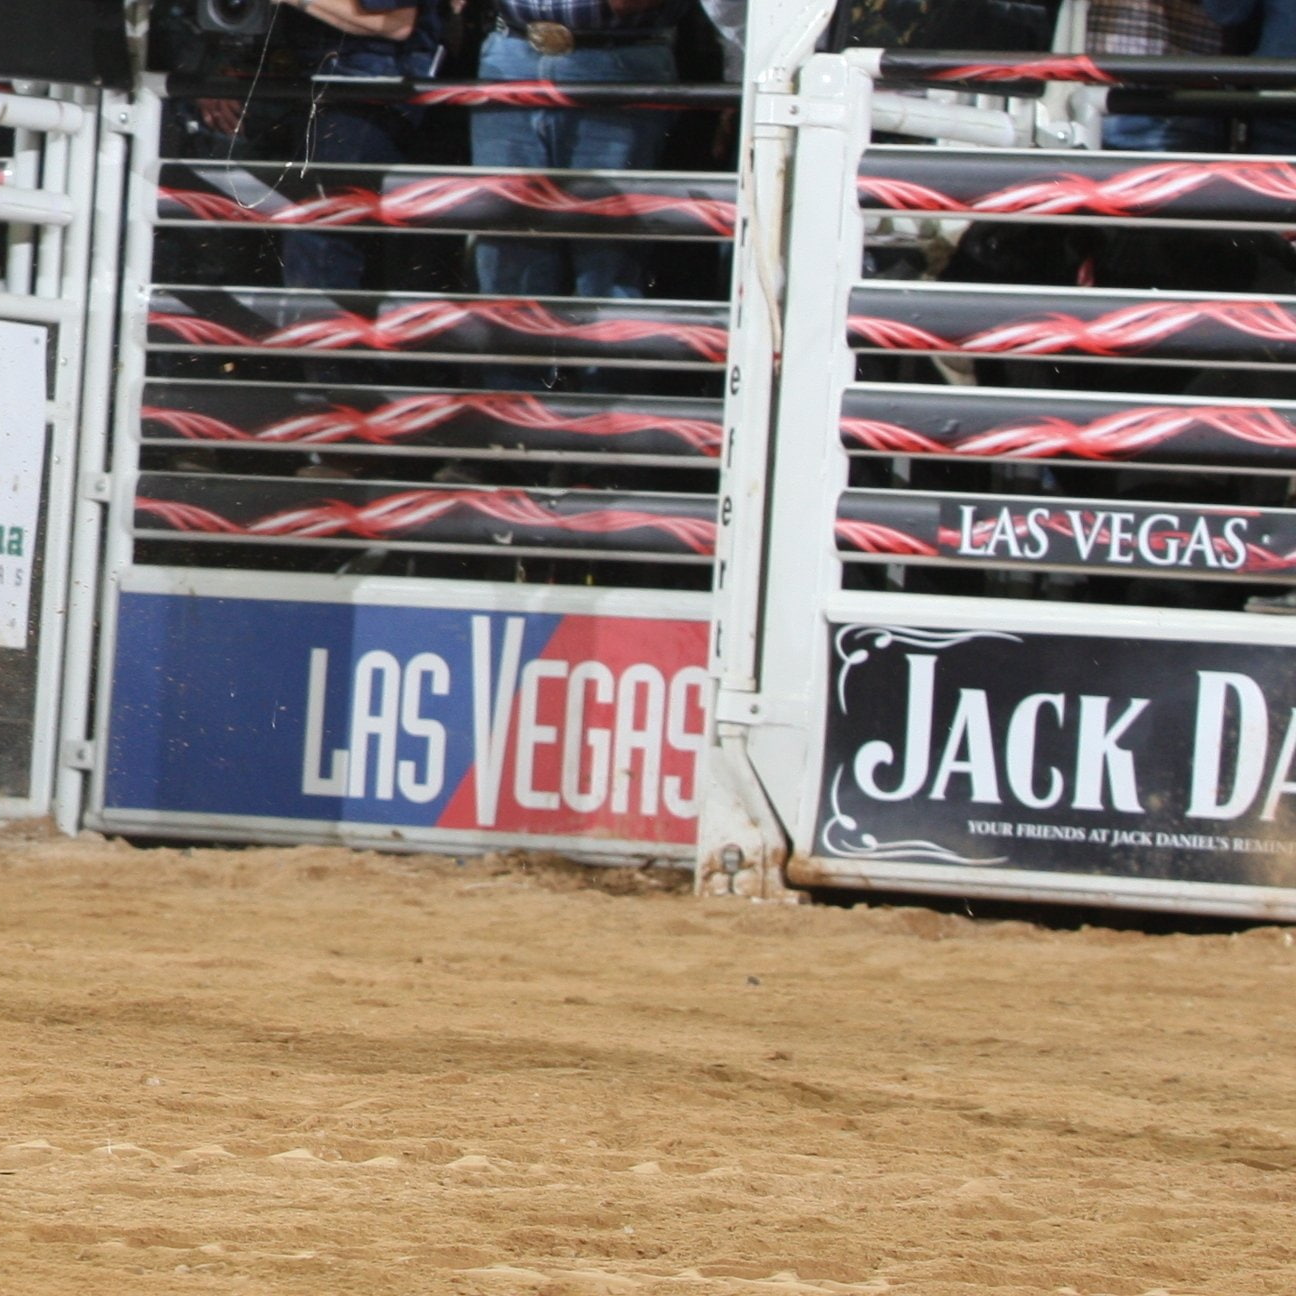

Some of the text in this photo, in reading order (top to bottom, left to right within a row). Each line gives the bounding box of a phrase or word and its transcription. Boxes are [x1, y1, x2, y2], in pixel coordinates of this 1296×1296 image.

[957, 505, 1249, 571] LAS VEGAS
[301, 614, 710, 828] LAS VEGAS
[853, 653, 1150, 815] JACK
[967, 819, 1013, 836] YOUR
[1015, 822, 1086, 841] FRIENDS
[1088, 828, 1111, 843] AT
[1110, 829, 1153, 847] JACK
[1155, 831, 1230, 851] DANIEL'S
